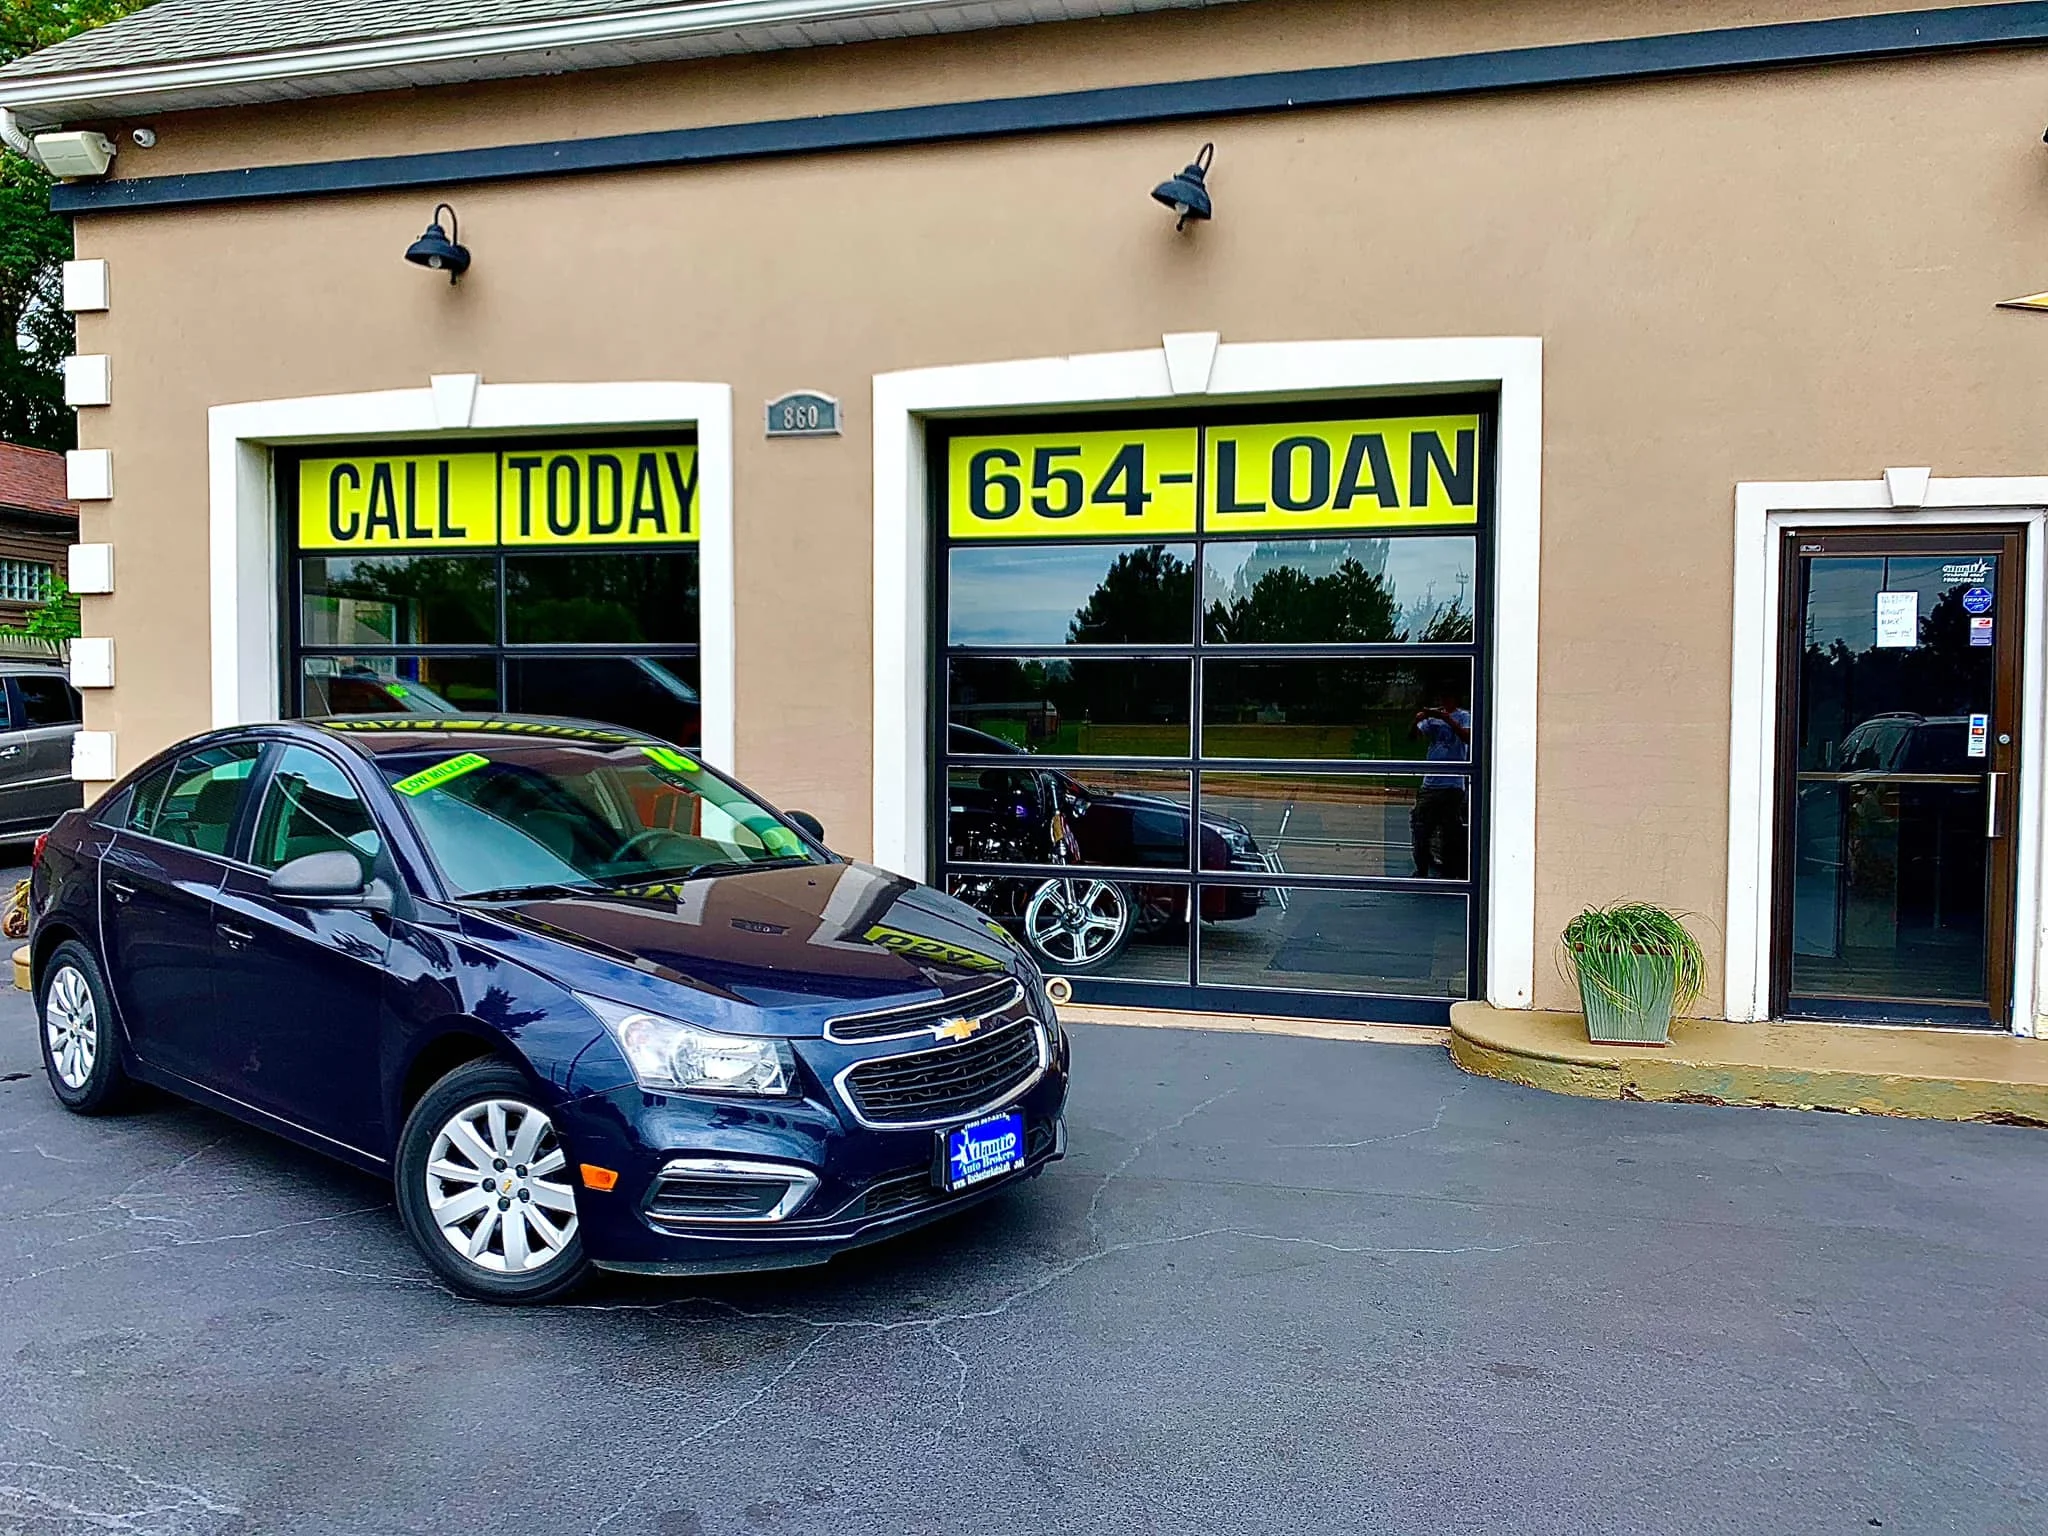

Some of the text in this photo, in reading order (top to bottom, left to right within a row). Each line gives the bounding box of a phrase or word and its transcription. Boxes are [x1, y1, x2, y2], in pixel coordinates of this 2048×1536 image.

[783, 404, 819, 429] 860
[329, 451, 699, 541] CALL TODAY
[399, 755, 482, 792] LOW MILEAGE
